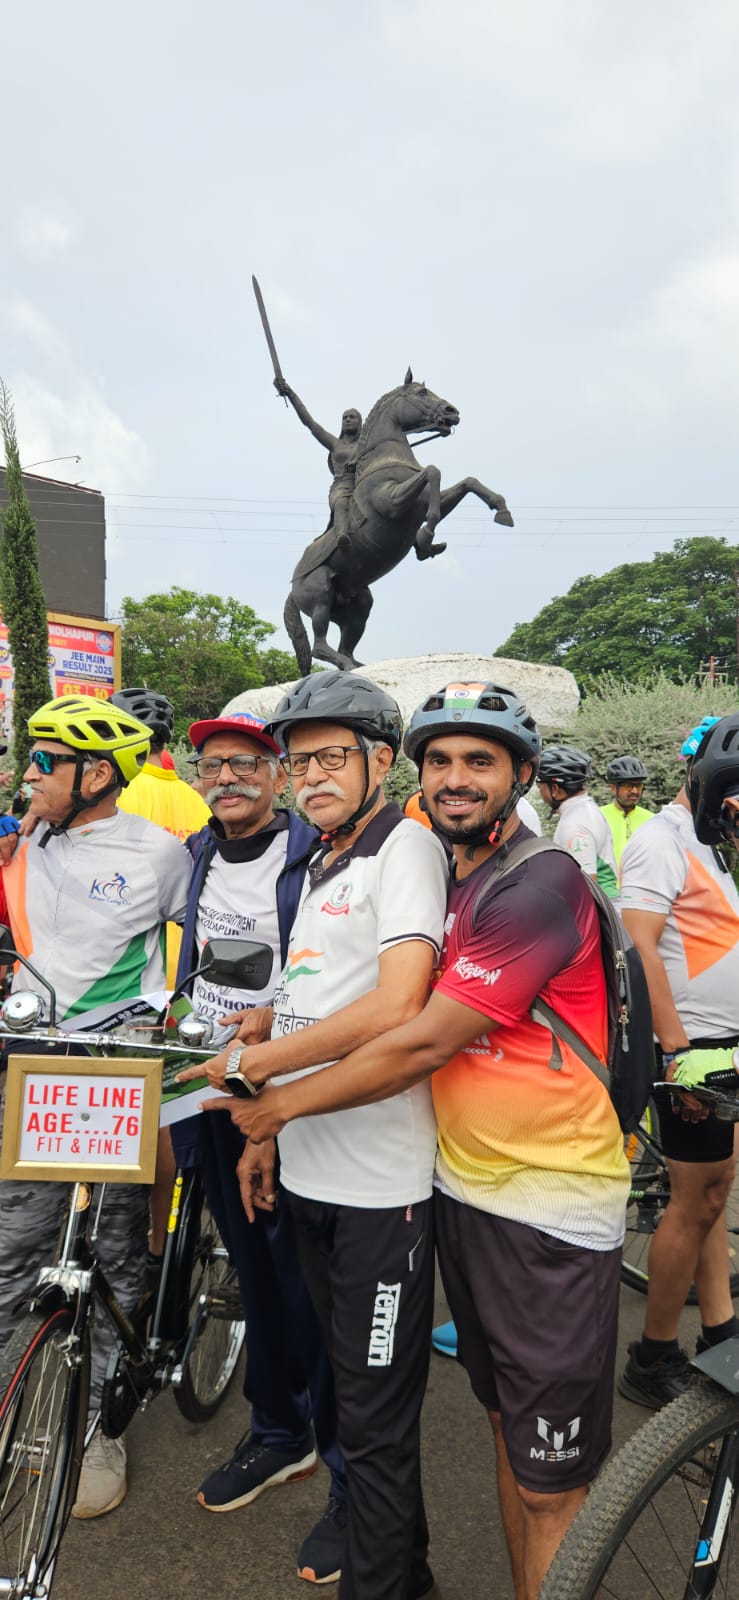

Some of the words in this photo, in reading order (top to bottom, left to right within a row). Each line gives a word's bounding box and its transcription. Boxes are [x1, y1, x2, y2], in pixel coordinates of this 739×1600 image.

[49, 626, 95, 642] KOLHAPUR
[70, 651, 85, 662] JEE
[86, 654, 105, 665] MAIN
[63, 660, 92, 673] RESULT
[94, 665, 113, 676] 2025
[28, 1084, 79, 1106] LIFE
[88, 1087, 142, 1109] LINE
[37, 1136, 63, 1152] FIT
[70, 1138, 80, 1154] &
[88, 1138, 123, 1155] FINE
[529, 1446, 580, 1462] MESSI
